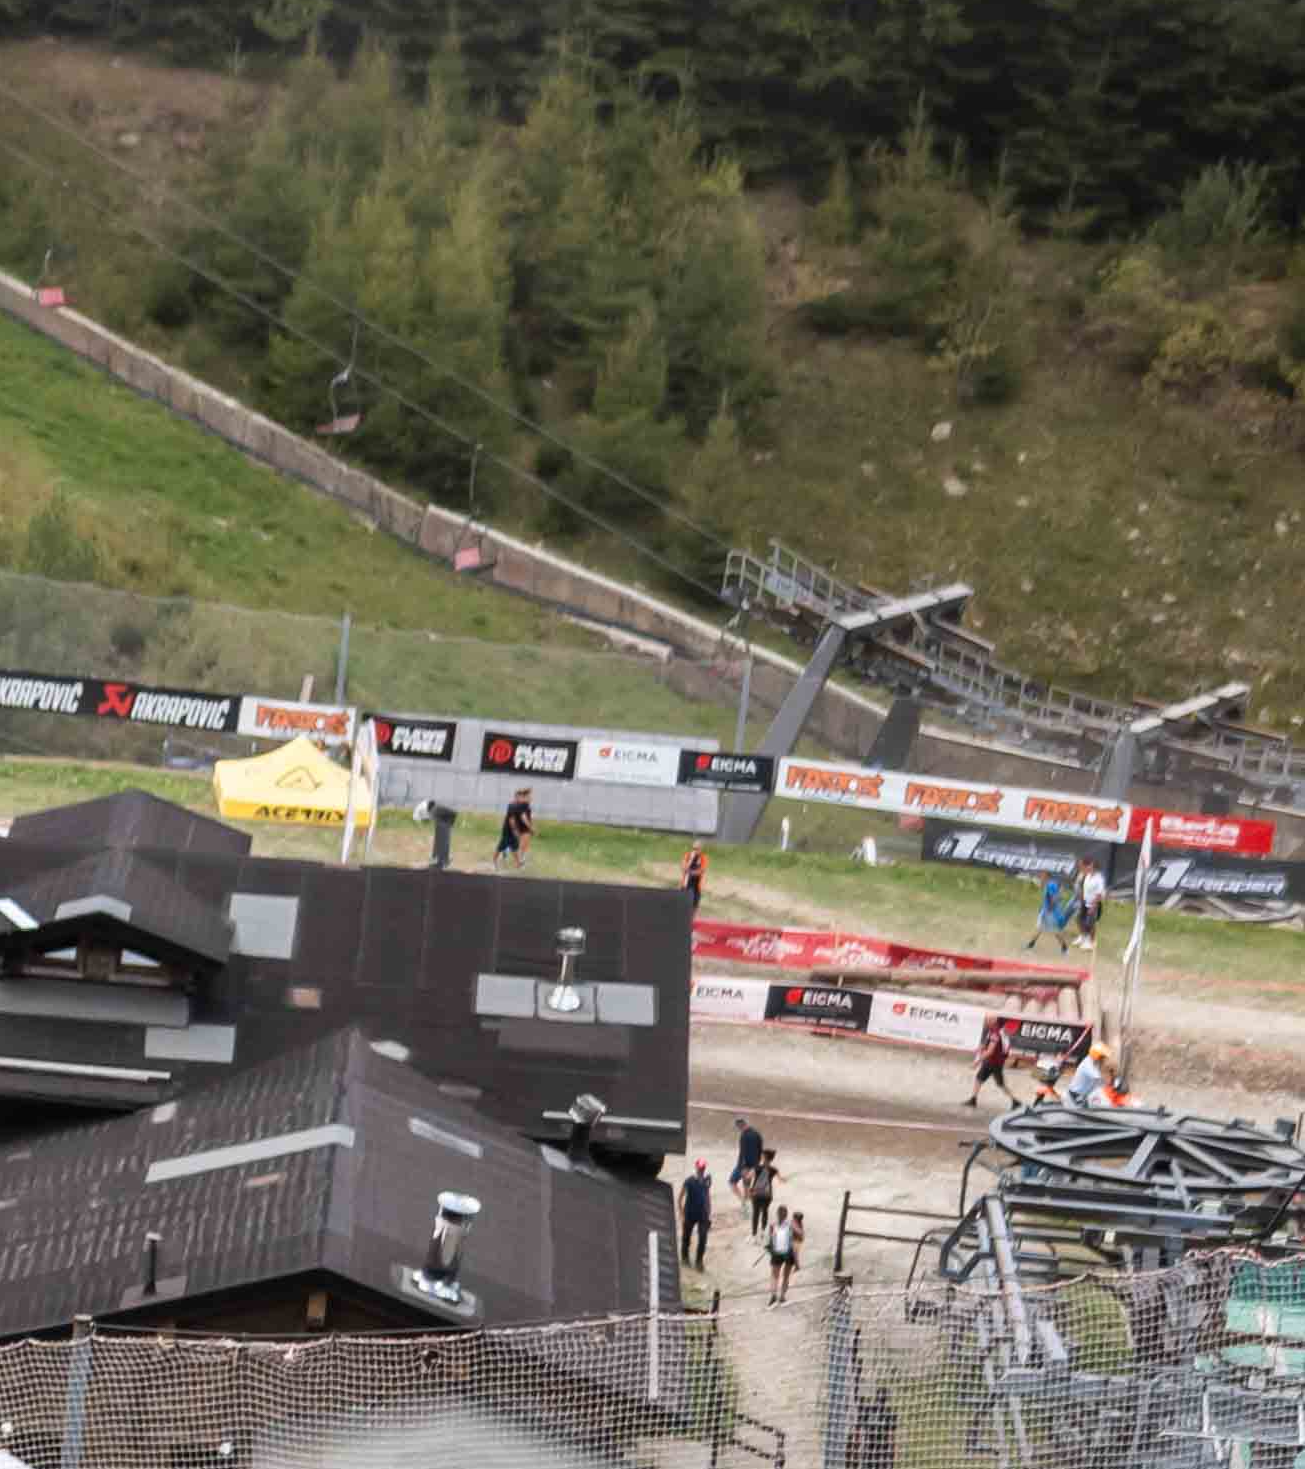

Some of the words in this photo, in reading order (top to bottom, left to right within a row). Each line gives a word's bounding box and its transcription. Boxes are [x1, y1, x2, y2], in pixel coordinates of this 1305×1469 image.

[711, 758, 757, 775] EICMA
[696, 986, 744, 1001] EICMA
[802, 988, 853, 1009] EICMA
[909, 1006, 960, 1024] EICMA
[1021, 1022, 1073, 1044] EICMA
